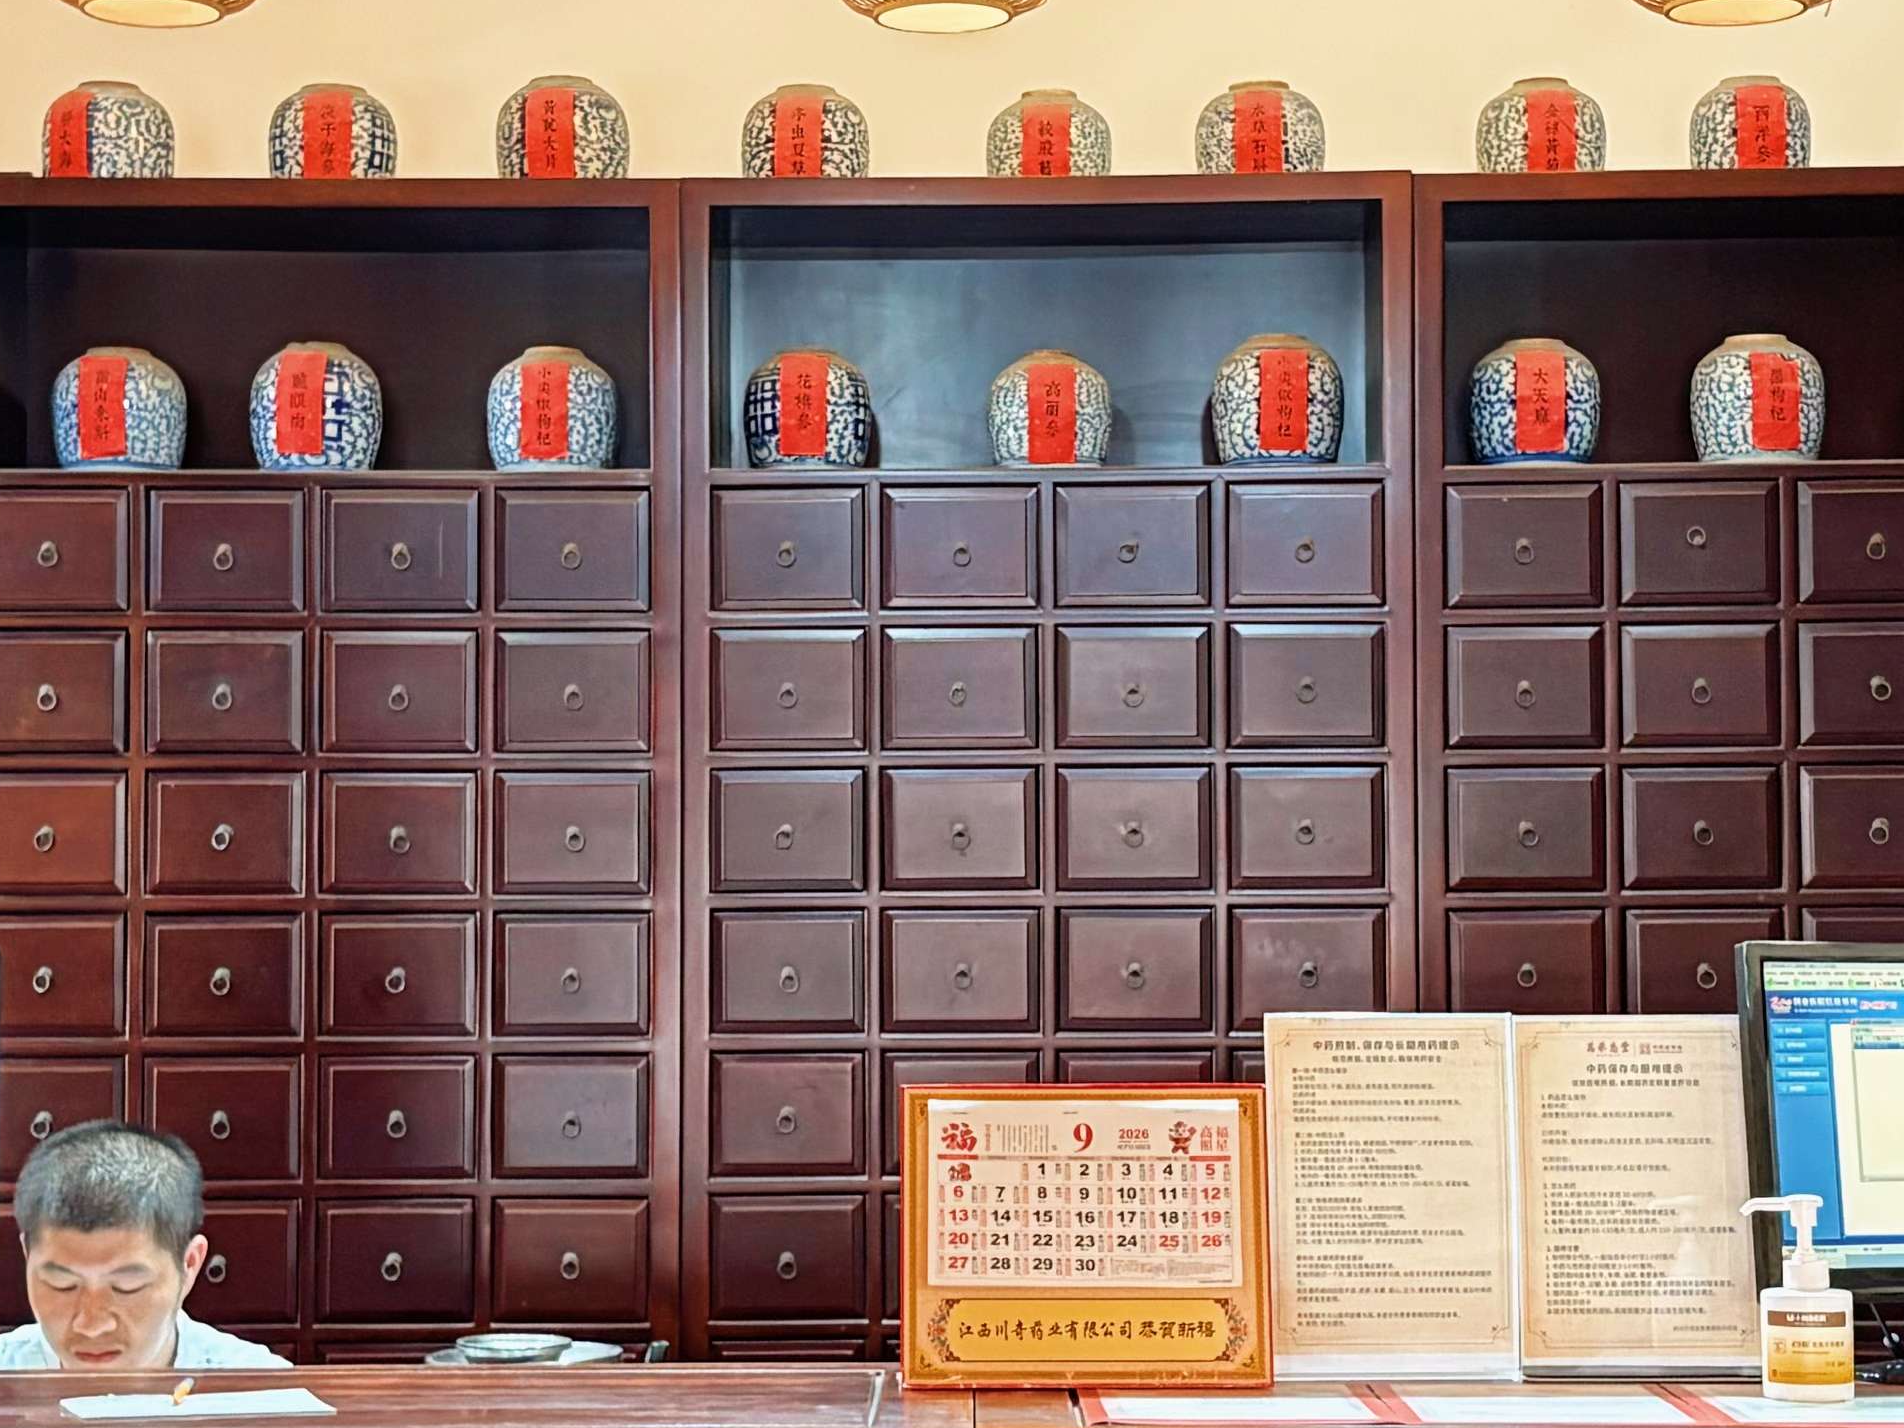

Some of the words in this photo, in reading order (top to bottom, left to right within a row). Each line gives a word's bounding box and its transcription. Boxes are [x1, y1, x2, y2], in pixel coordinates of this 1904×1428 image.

[1073, 1123, 1094, 1153] 9
[1119, 1128, 1149, 1139] 2026
[1037, 1163, 1046, 1175] 1
[1079, 1164, 1090, 1176] 2
[1121, 1164, 1132, 1176] 3
[1162, 1164, 1174, 1176] 4
[1205, 1164, 1216, 1176] 5
[953, 1186, 964, 1198] 6
[995, 1187, 1006, 1199] 7
[1037, 1187, 1047, 1199] 8
[1079, 1188, 1089, 1200] 9
[1116, 1187, 1137, 1200] 10
[1159, 1188, 1178, 1200] 11
[1201, 1187, 1221, 1200] 12
[948, 1209, 969, 1221] 13
[991, 1210, 1011, 1223] 14
[1033, 1210, 1053, 1223] 15
[1075, 1211, 1095, 1224] 16
[1116, 1211, 1137, 1224] 17
[1159, 1211, 1179, 1224] 18
[1201, 1211, 1221, 1224] 19
[948, 1232, 969, 1245] 20
[991, 1234, 1010, 1246] 21
[1032, 1234, 1053, 1247] 22
[1074, 1235, 1095, 1248] 23
[1116, 1234, 1138, 1248] 24
[1159, 1235, 1180, 1248] 25
[1201, 1234, 1223, 1248] 26
[948, 1256, 969, 1269] 27
[990, 1257, 1011, 1270] 28
[1032, 1258, 1053, 1270] 29
[1074, 1259, 1095, 1272] 30
